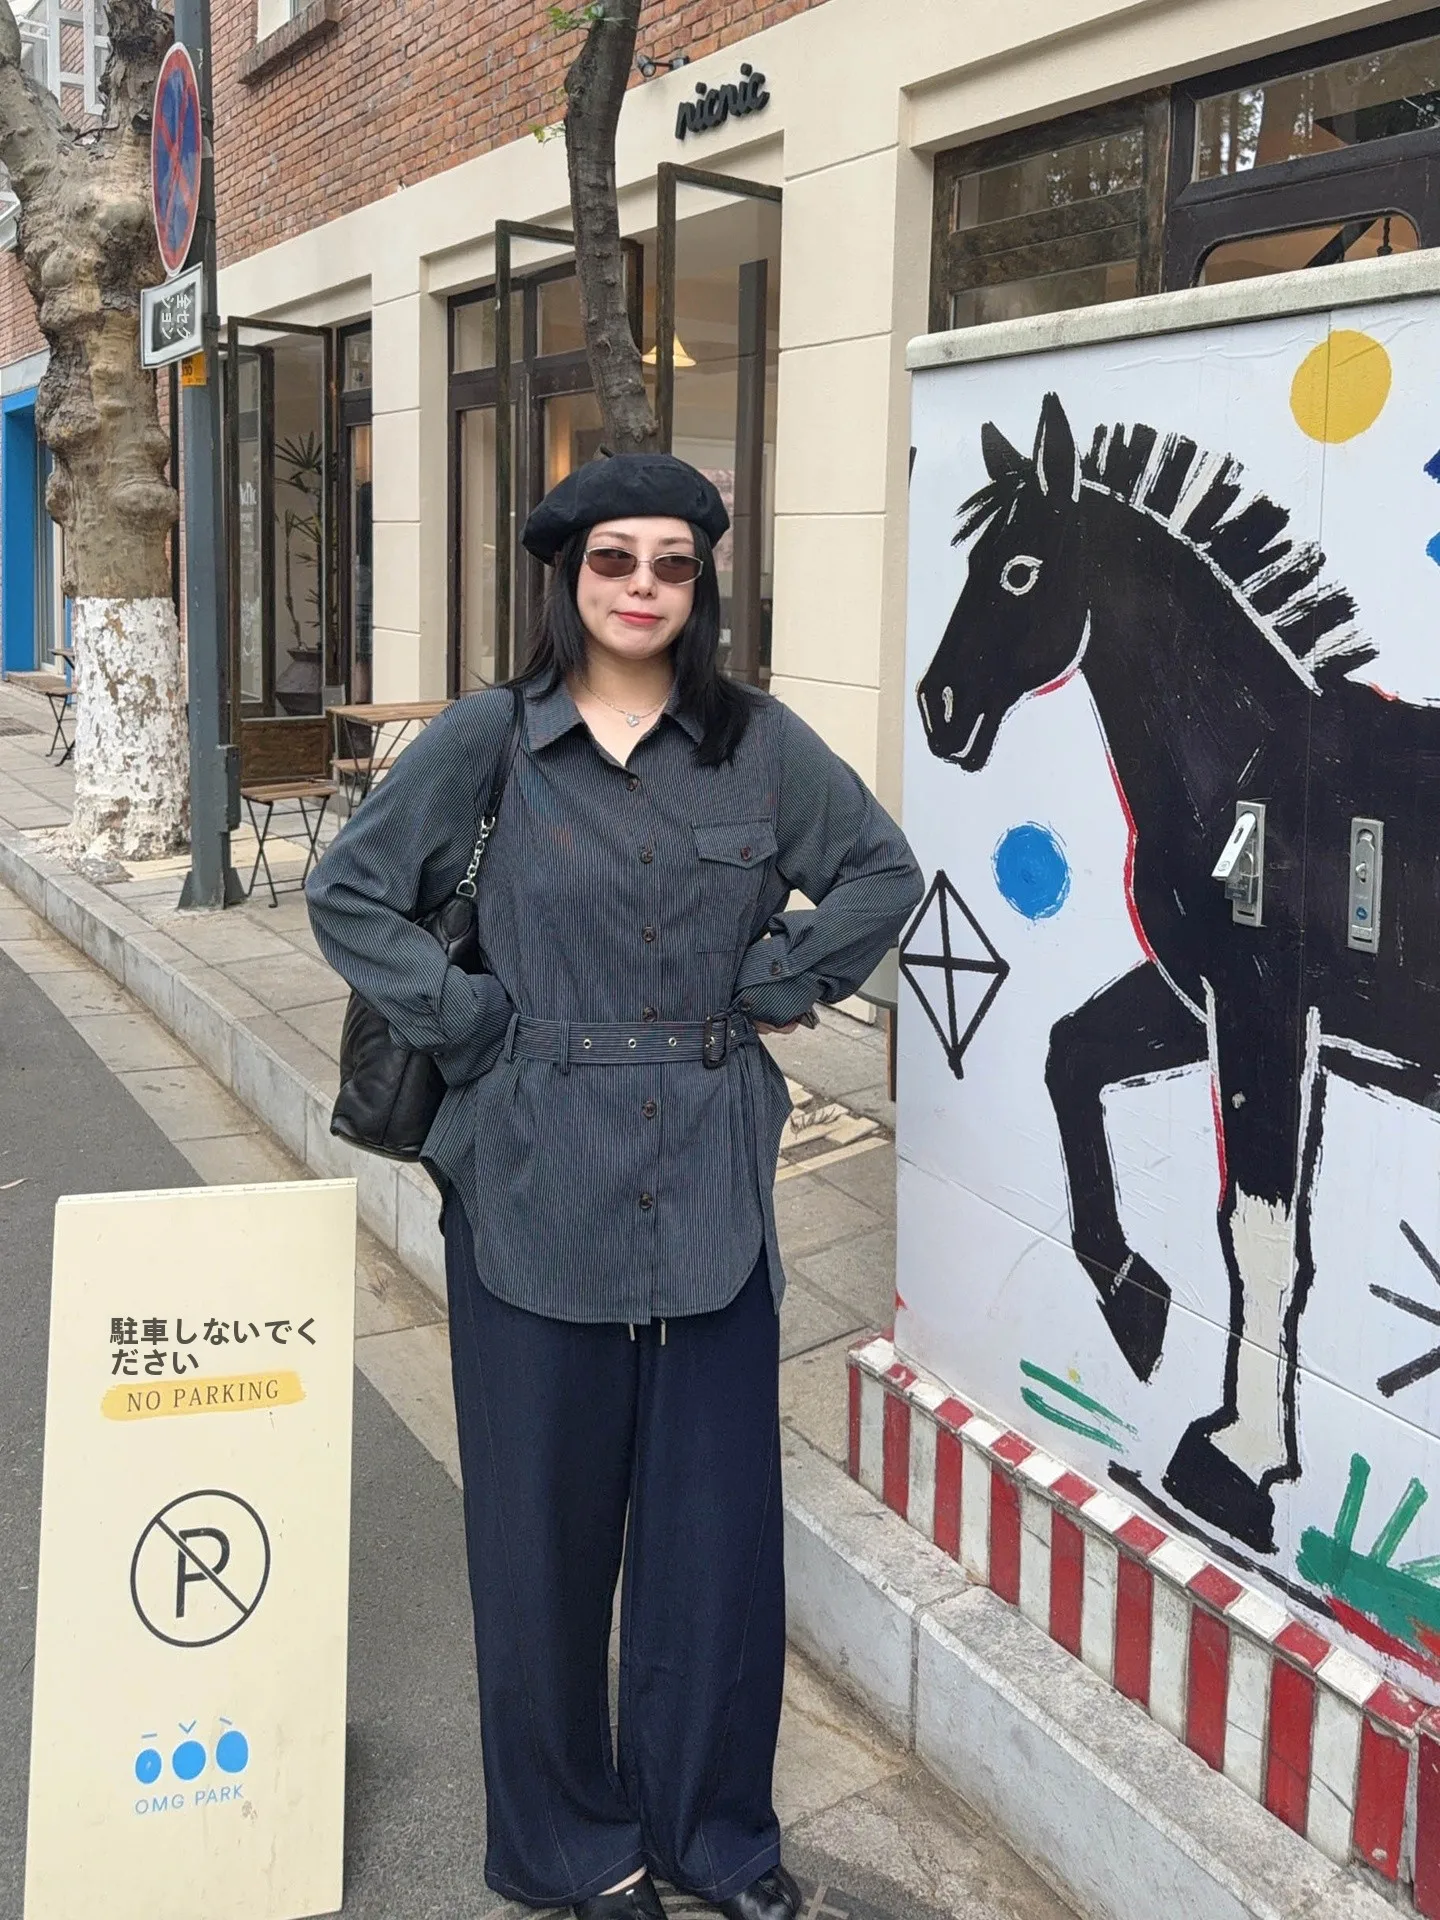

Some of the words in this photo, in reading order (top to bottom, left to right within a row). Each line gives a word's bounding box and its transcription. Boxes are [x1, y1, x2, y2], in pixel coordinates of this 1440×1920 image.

[109, 1316, 317, 1346] 駐車しないでく
[111, 1348, 199, 1376] ださい
[127, 1390, 161, 1413] NO
[173, 1379, 280, 1408] PARKING
[135, 1793, 185, 1815] OMG
[195, 1783, 244, 1806] PARK
